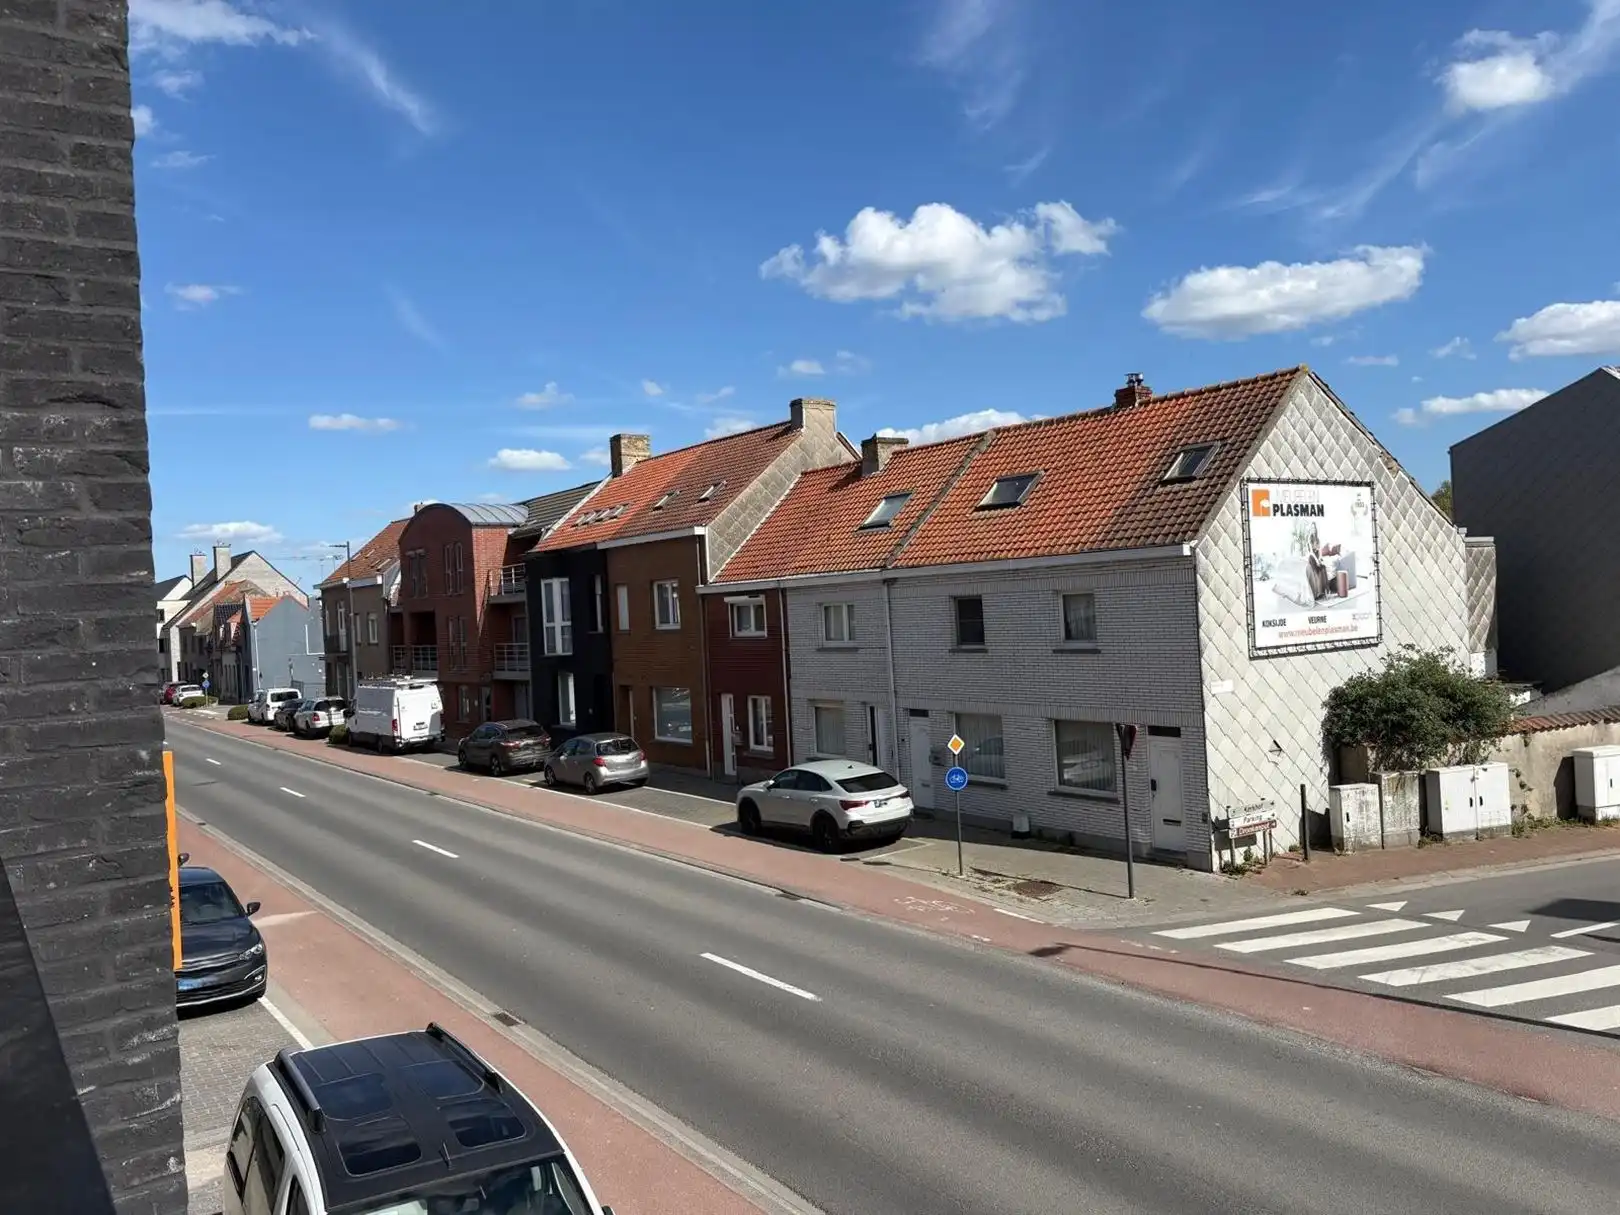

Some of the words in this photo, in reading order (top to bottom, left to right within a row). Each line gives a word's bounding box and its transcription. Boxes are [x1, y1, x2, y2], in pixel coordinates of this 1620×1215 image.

[1272, 503, 1325, 517] PLASMAN
[1262, 617, 1287, 628] KOKSIJDE
[1308, 615, 1327, 624] VEURNE
